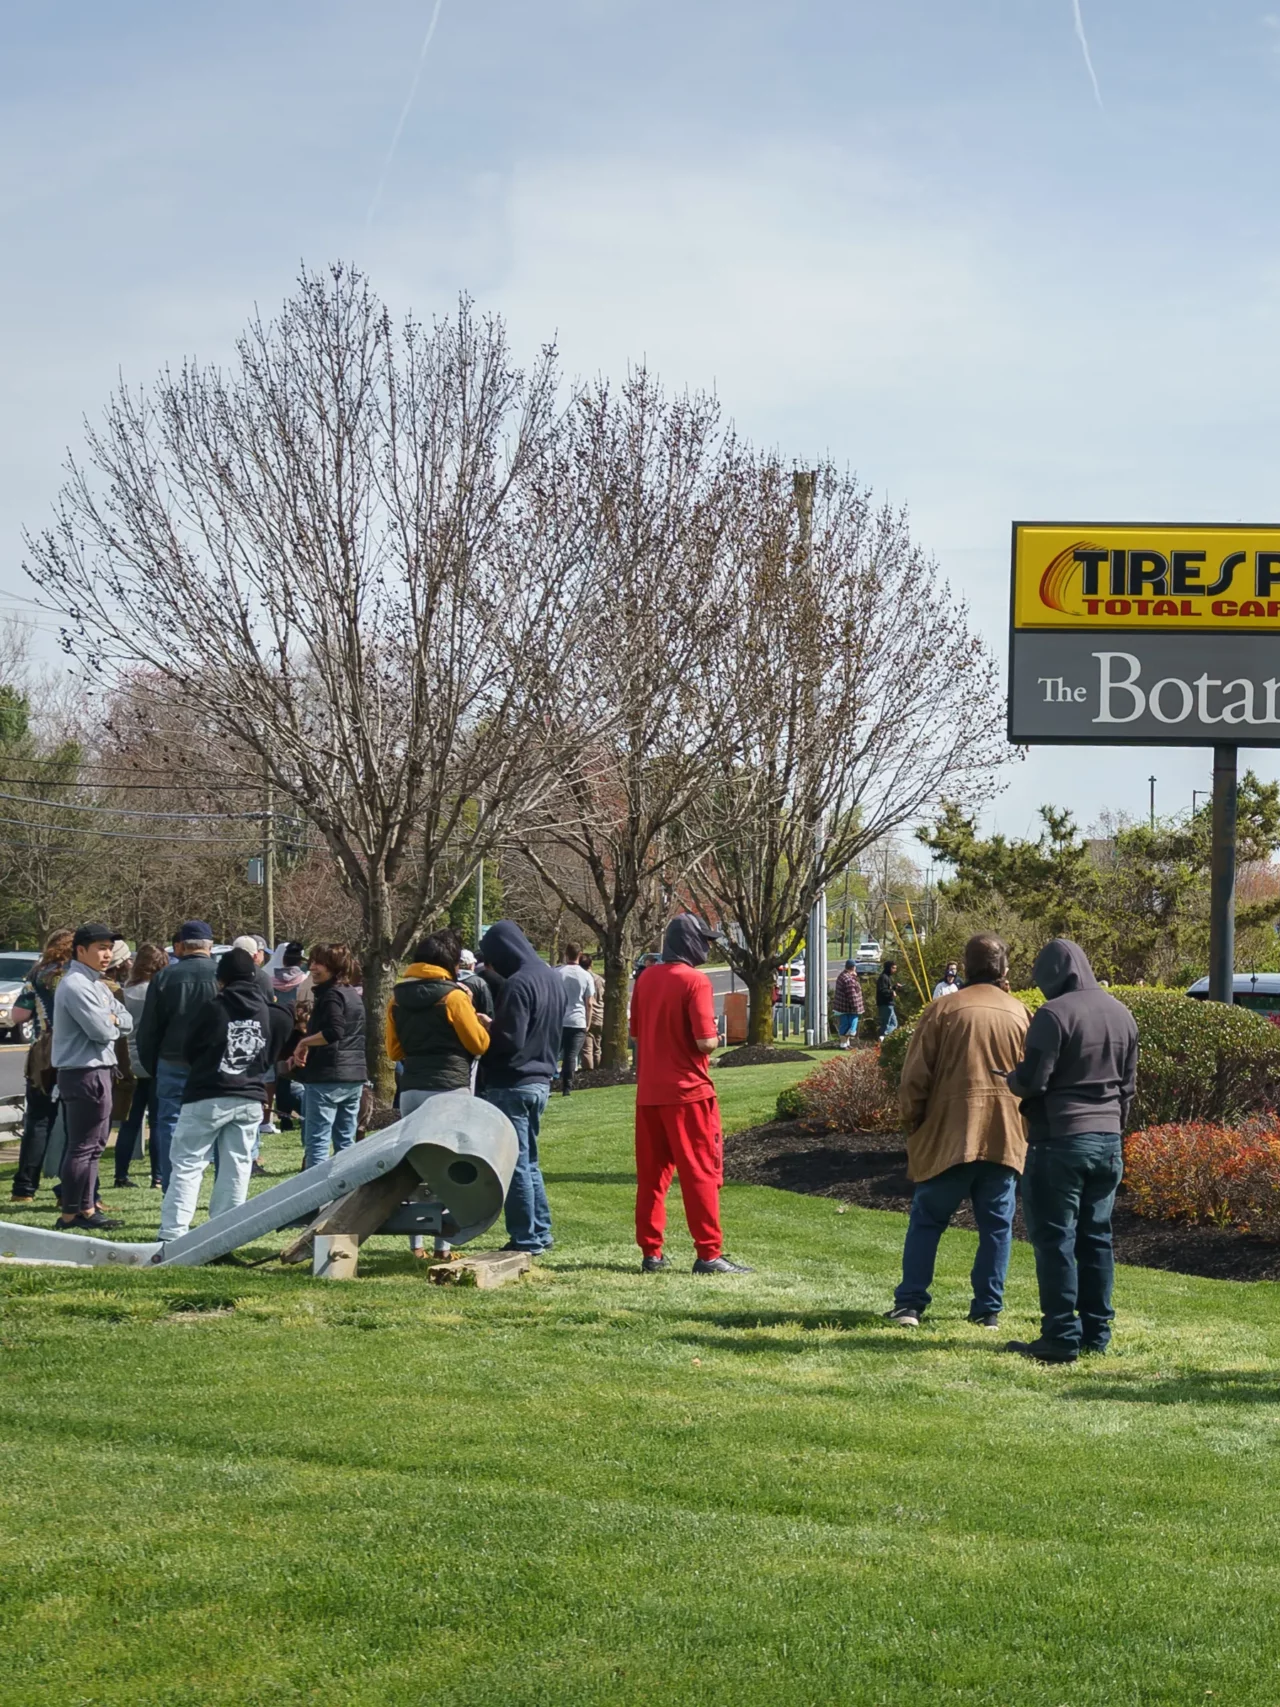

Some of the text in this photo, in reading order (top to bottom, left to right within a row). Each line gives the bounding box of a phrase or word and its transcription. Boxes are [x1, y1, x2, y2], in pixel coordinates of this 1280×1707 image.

[1073, 549, 1246, 597] TIRES
[1082, 599, 1202, 616] TOTAL
[1038, 677, 1087, 703] The
